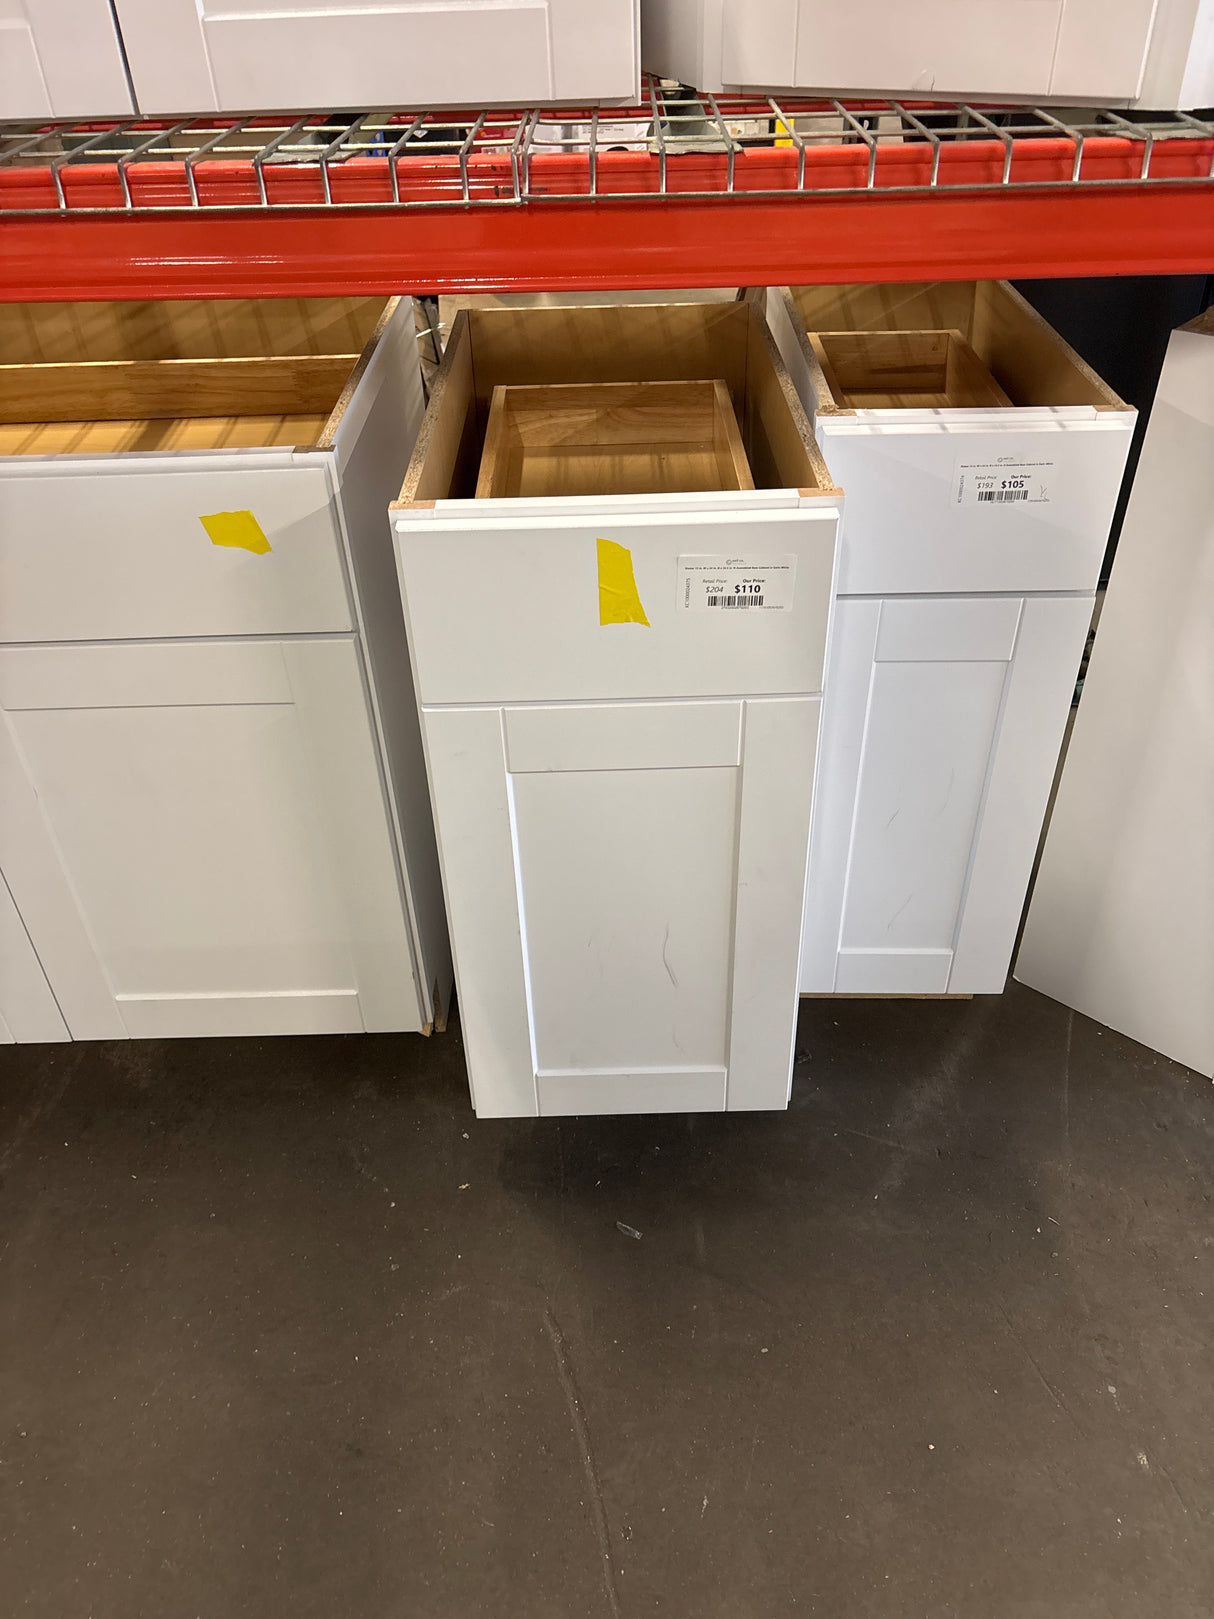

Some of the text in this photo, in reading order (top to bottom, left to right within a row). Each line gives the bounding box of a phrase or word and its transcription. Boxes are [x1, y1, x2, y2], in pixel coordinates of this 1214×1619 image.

[977, 481, 994, 489] $193
[1001, 480, 1025, 489] $105
[734, 584, 761, 594] $110
